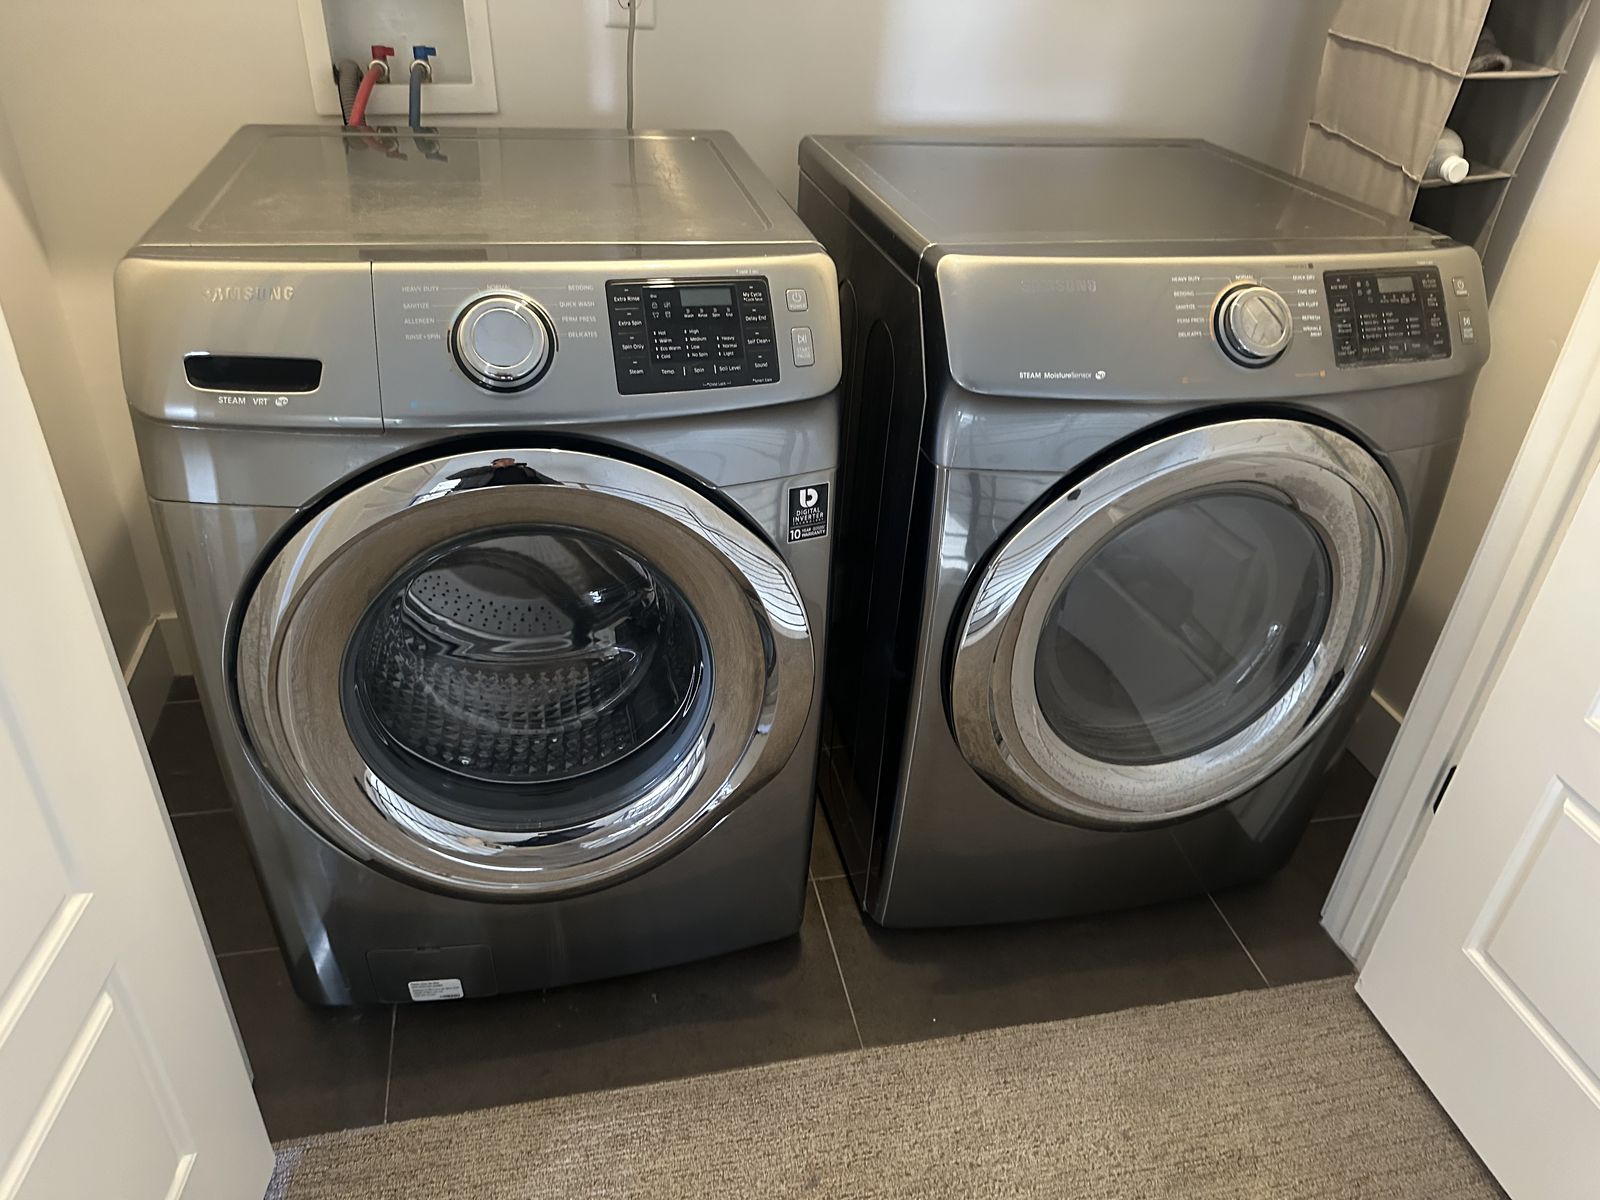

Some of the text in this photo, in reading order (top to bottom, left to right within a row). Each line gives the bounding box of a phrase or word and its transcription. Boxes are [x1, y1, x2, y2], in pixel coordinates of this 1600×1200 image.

[567, 330, 598, 338] DELICATES
[1019, 371, 1042, 379] STEAM
[218, 396, 246, 405] STEAM
[252, 397, 268, 406] VRT
[796, 507, 820, 516] DIGITAL
[792, 512, 824, 522] INVERTER
[790, 529, 801, 540] 10
[801, 529, 826, 538] WARRANTY
